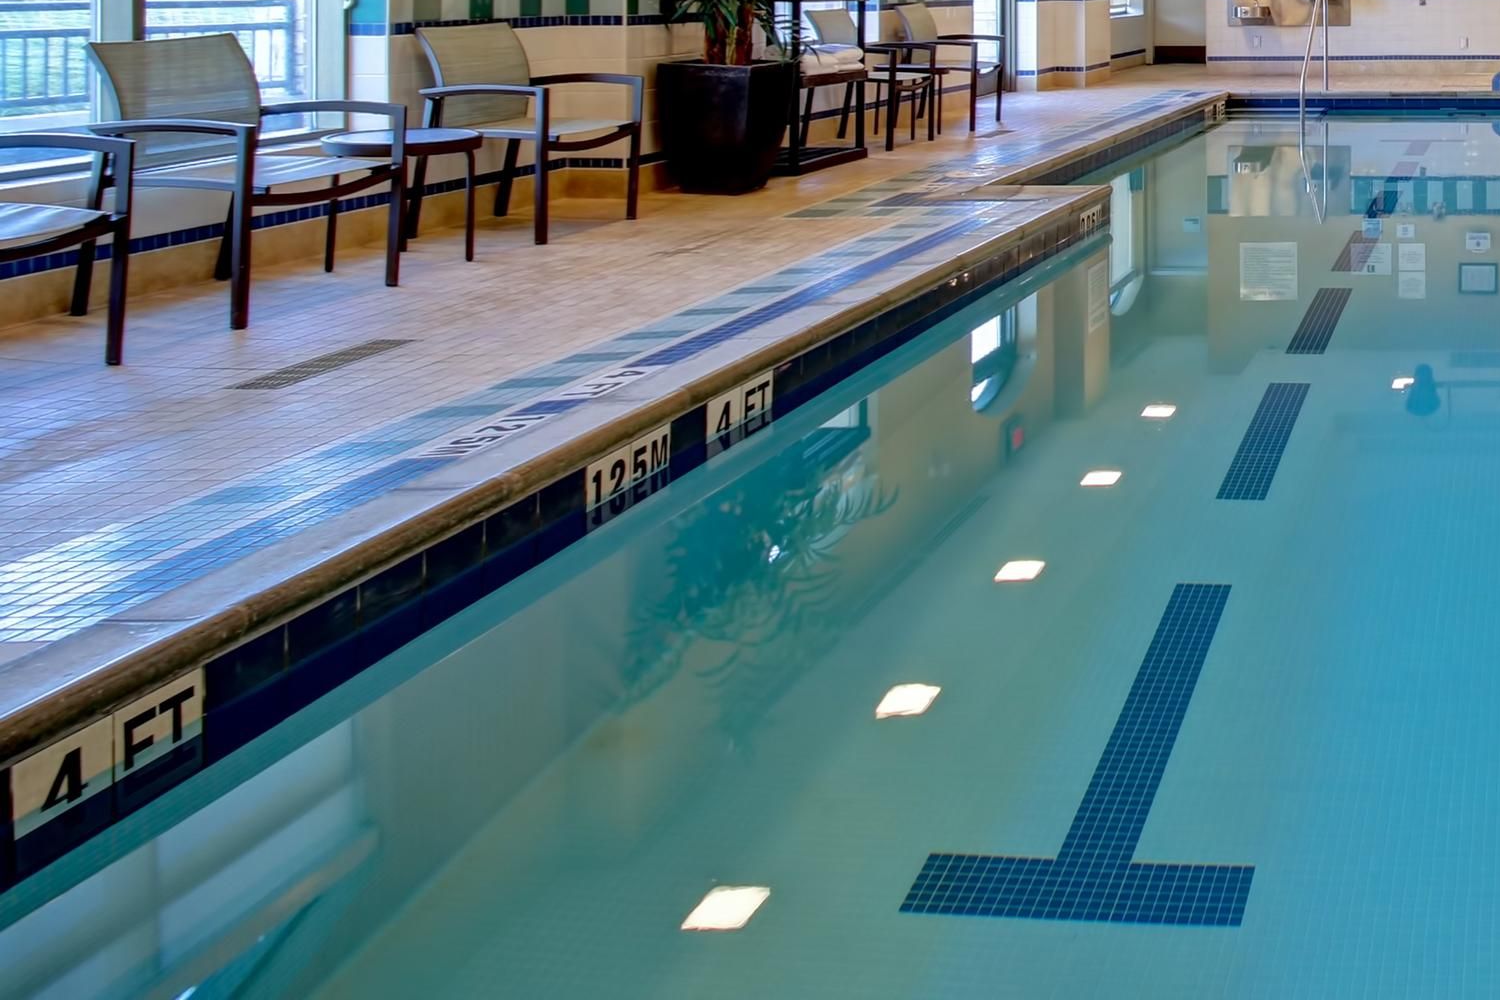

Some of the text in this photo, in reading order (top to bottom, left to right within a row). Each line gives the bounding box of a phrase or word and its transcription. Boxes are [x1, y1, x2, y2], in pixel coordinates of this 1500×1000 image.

[716, 380, 770, 434] 4 FT
[40, 685, 195, 813] 4 FT
